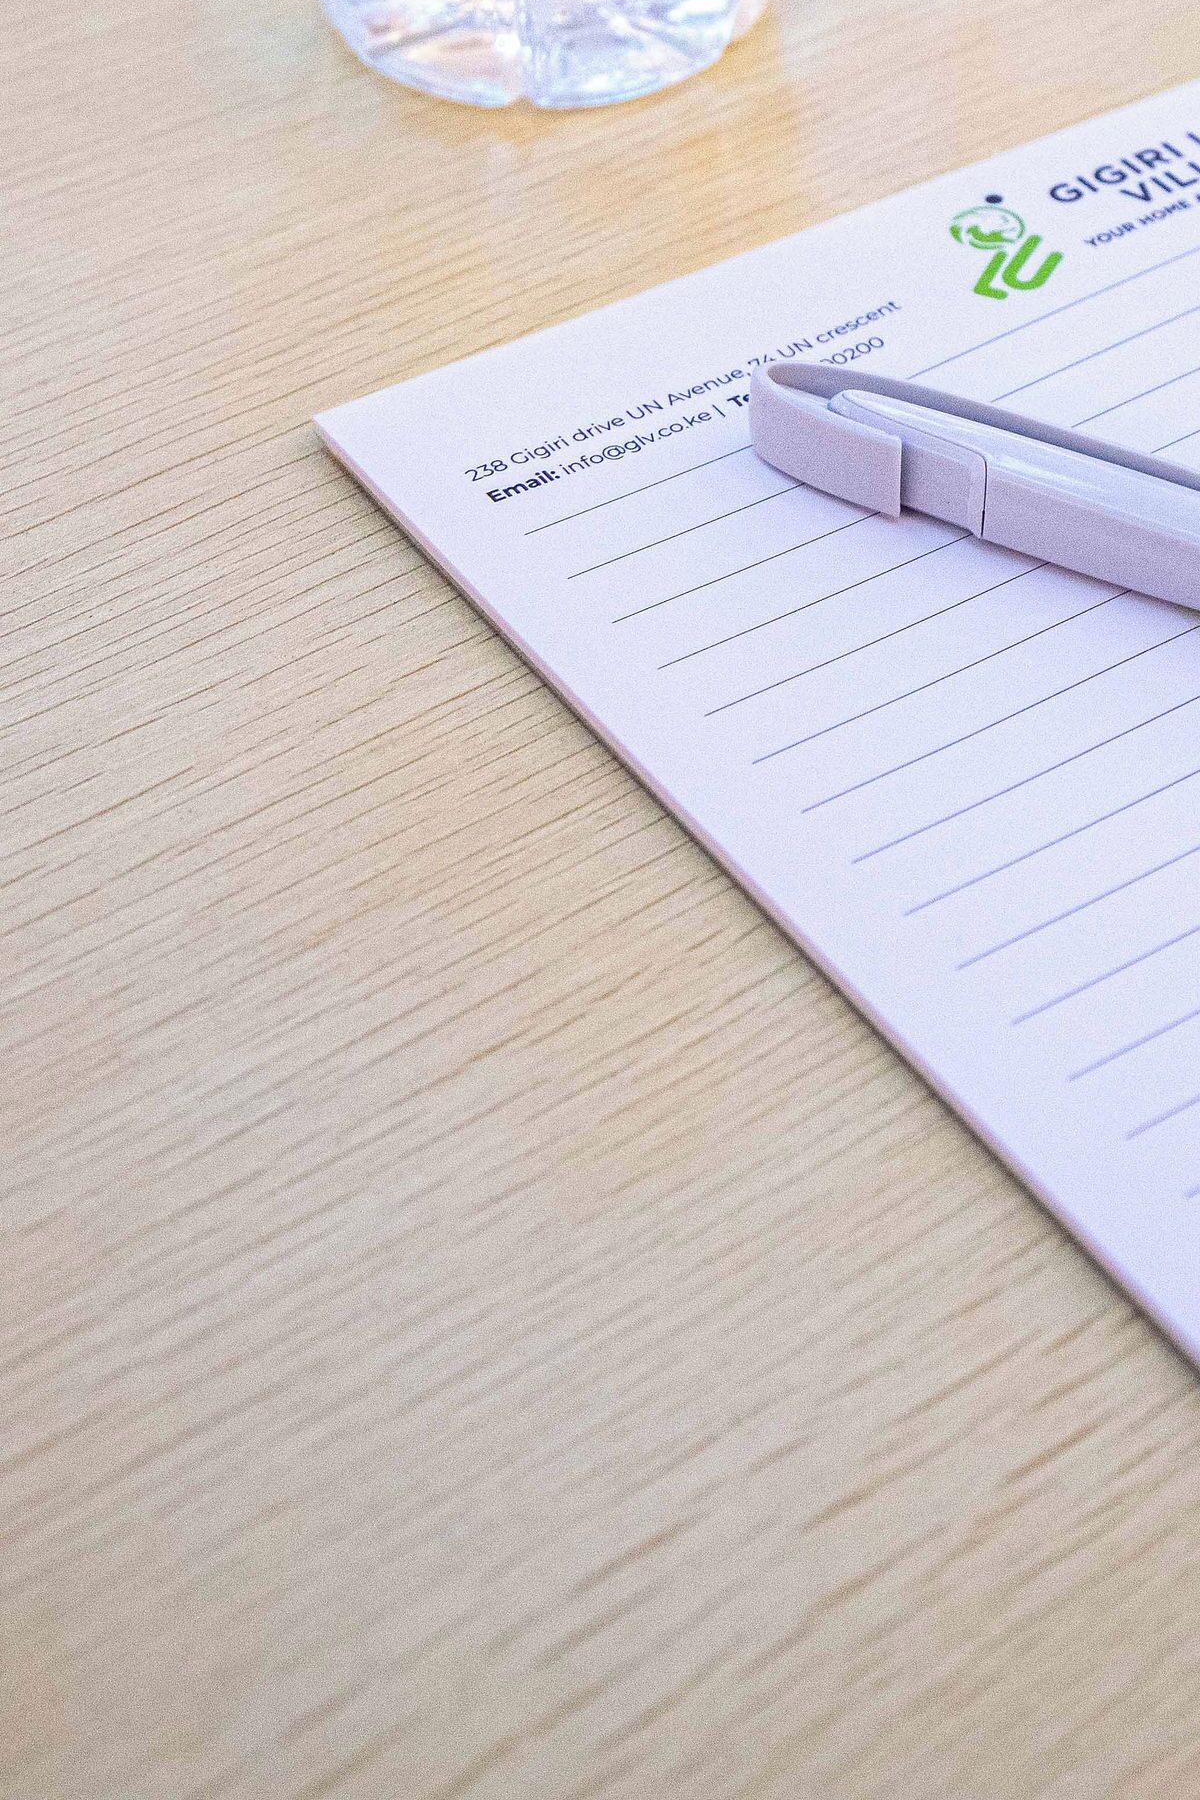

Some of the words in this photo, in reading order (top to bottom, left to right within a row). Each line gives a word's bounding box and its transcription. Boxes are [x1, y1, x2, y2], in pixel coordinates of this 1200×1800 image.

[1048, 141, 1184, 204] GIGIRI
[1083, 221, 1137, 247] YOUR
[1138, 199, 1193, 226] HOME
[464, 459, 508, 482] 238
[510, 435, 571, 466] Gigiri
[572, 414, 626, 443] drive
[625, 399, 665, 421] UN
[667, 368, 752, 407] Avenue,
[776, 337, 813, 359] UN
[816, 301, 902, 344] crescent
[486, 468, 561, 503] Email:
[559, 410, 712, 476] info@glv.co.ke
